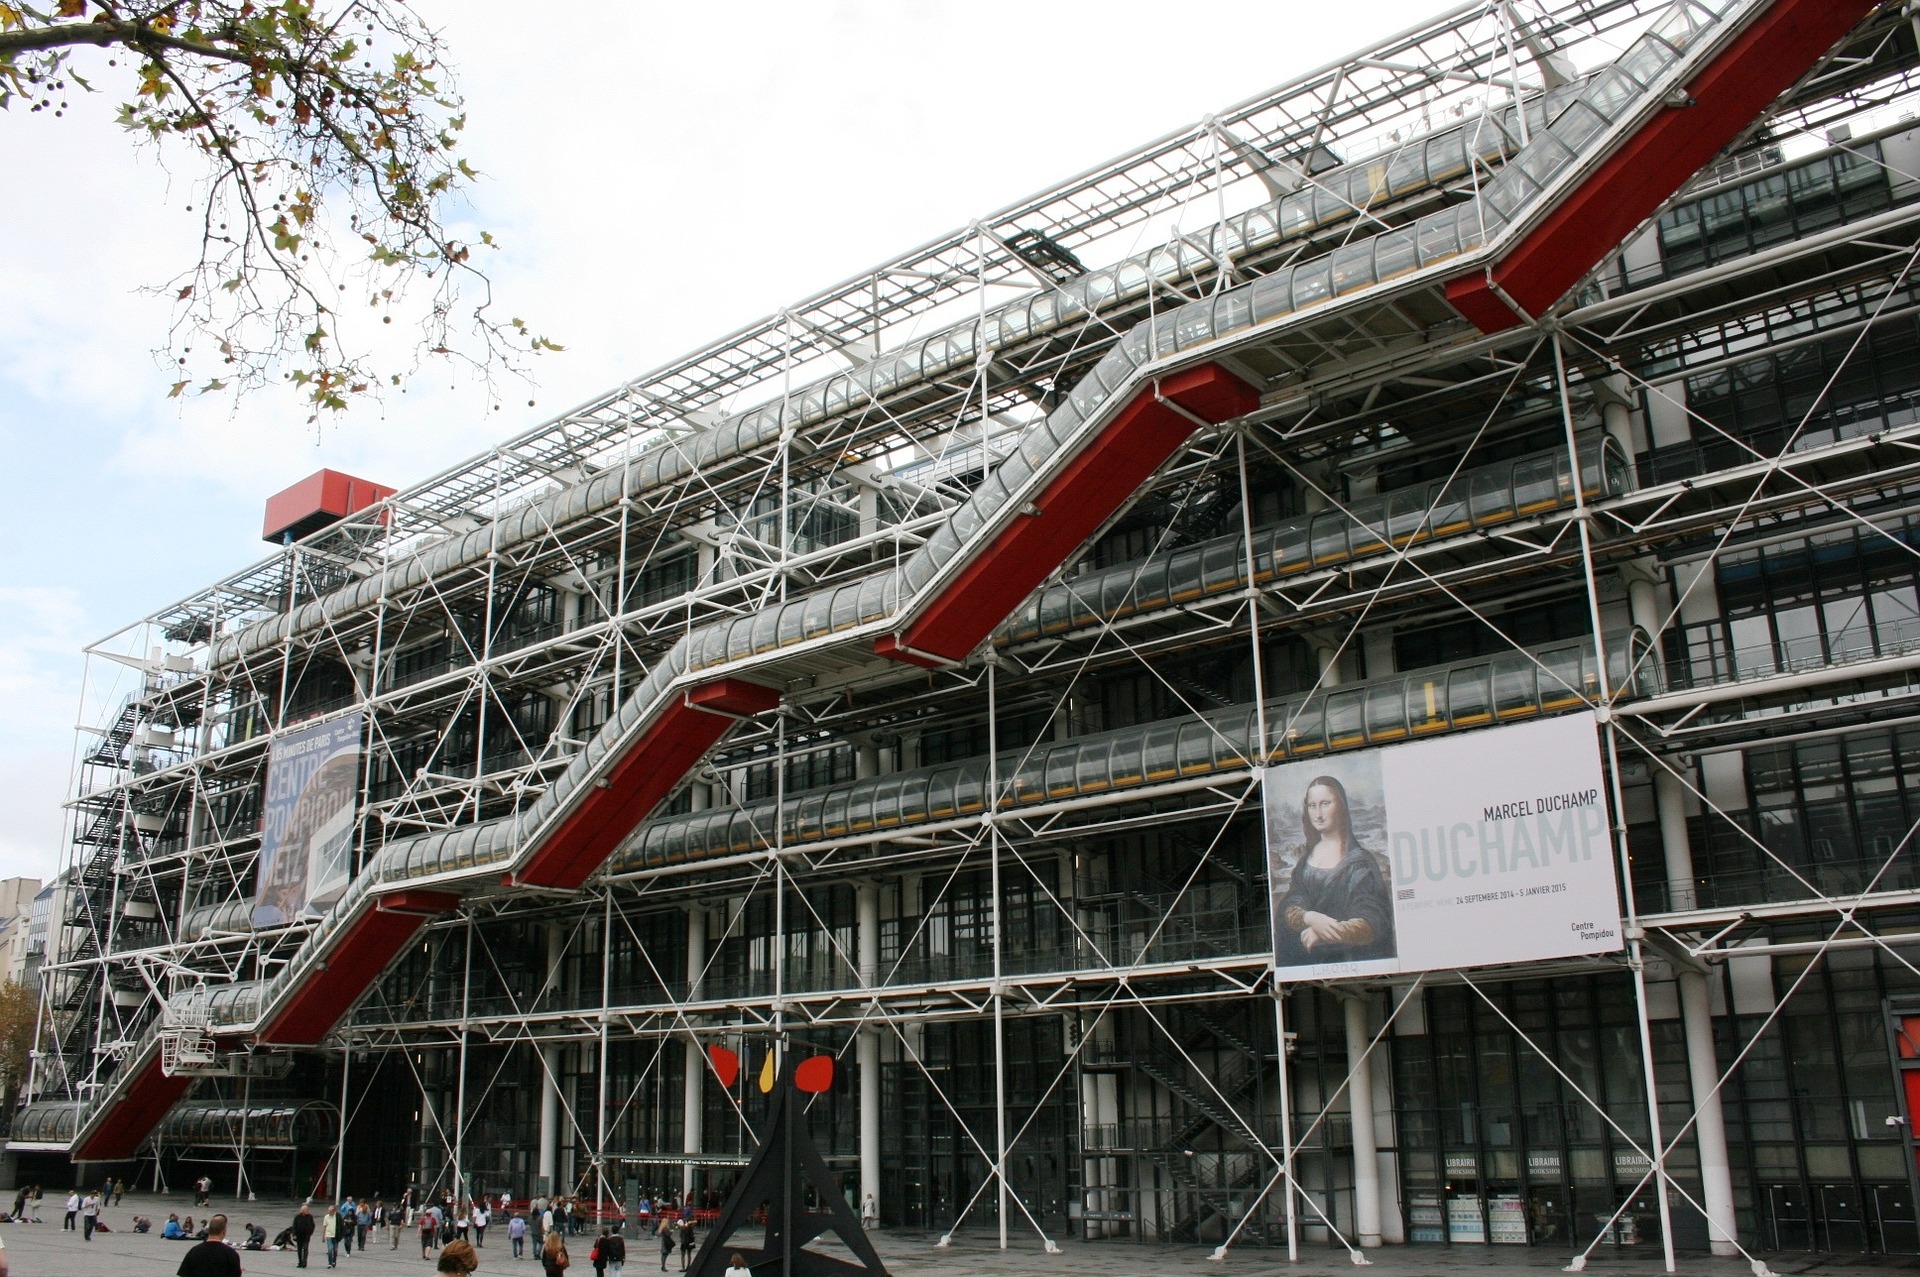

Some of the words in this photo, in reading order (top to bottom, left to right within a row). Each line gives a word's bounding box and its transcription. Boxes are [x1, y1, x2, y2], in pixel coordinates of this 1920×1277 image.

[283, 740, 306, 758] MINUTES
[306, 737, 315, 752] DE
[314, 733, 331, 749] PARIS
[267, 752, 329, 803] CENTRE
[265, 786, 352, 844] POMPIDOU
[1483, 801, 1533, 822] MARCEL
[1537, 789, 1598, 814] DUCHAMP
[1392, 803, 1606, 886] DUCHAMP
[259, 843, 303, 889] METZ
[1456, 896, 1464, 905] 24
[1464, 892, 1499, 904] SEPTEMBRE
[1500, 890, 1515, 899] 2014
[1520, 889, 1524, 897] 5
[1525, 885, 1550, 896] JANVIER
[1551, 883, 1567, 892] 2015
[1571, 921, 1594, 932] Centre
[1580, 929, 1614, 941] Pompidou
[1446, 1158, 1475, 1167] LIBRAIRIE
[1528, 1157, 1560, 1166] LIBRAIRIE
[1615, 1156, 1650, 1165] LIBRAIRIE
